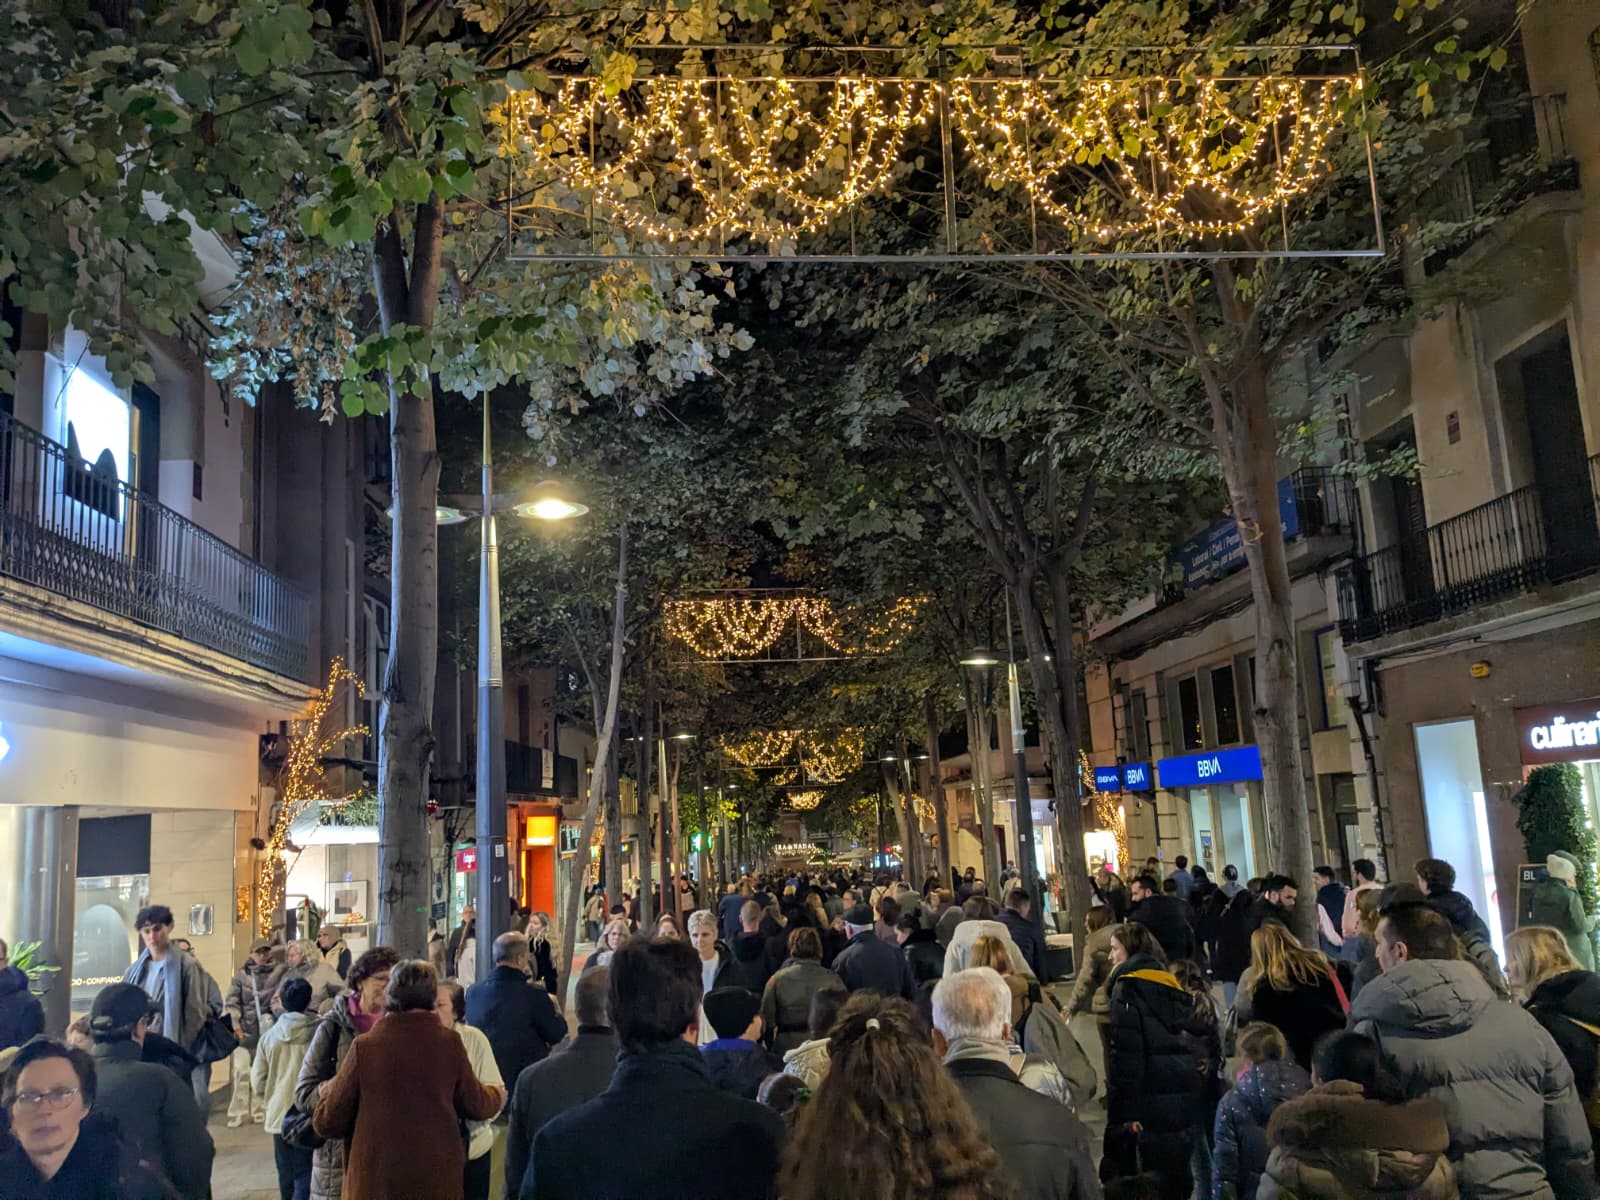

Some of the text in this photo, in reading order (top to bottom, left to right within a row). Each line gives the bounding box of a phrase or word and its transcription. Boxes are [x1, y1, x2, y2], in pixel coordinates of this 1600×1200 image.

[1127, 767, 1145, 785] BBVA
[1197, 756, 1222, 778] BBVA
[1097, 775, 1118, 784] BBVA
